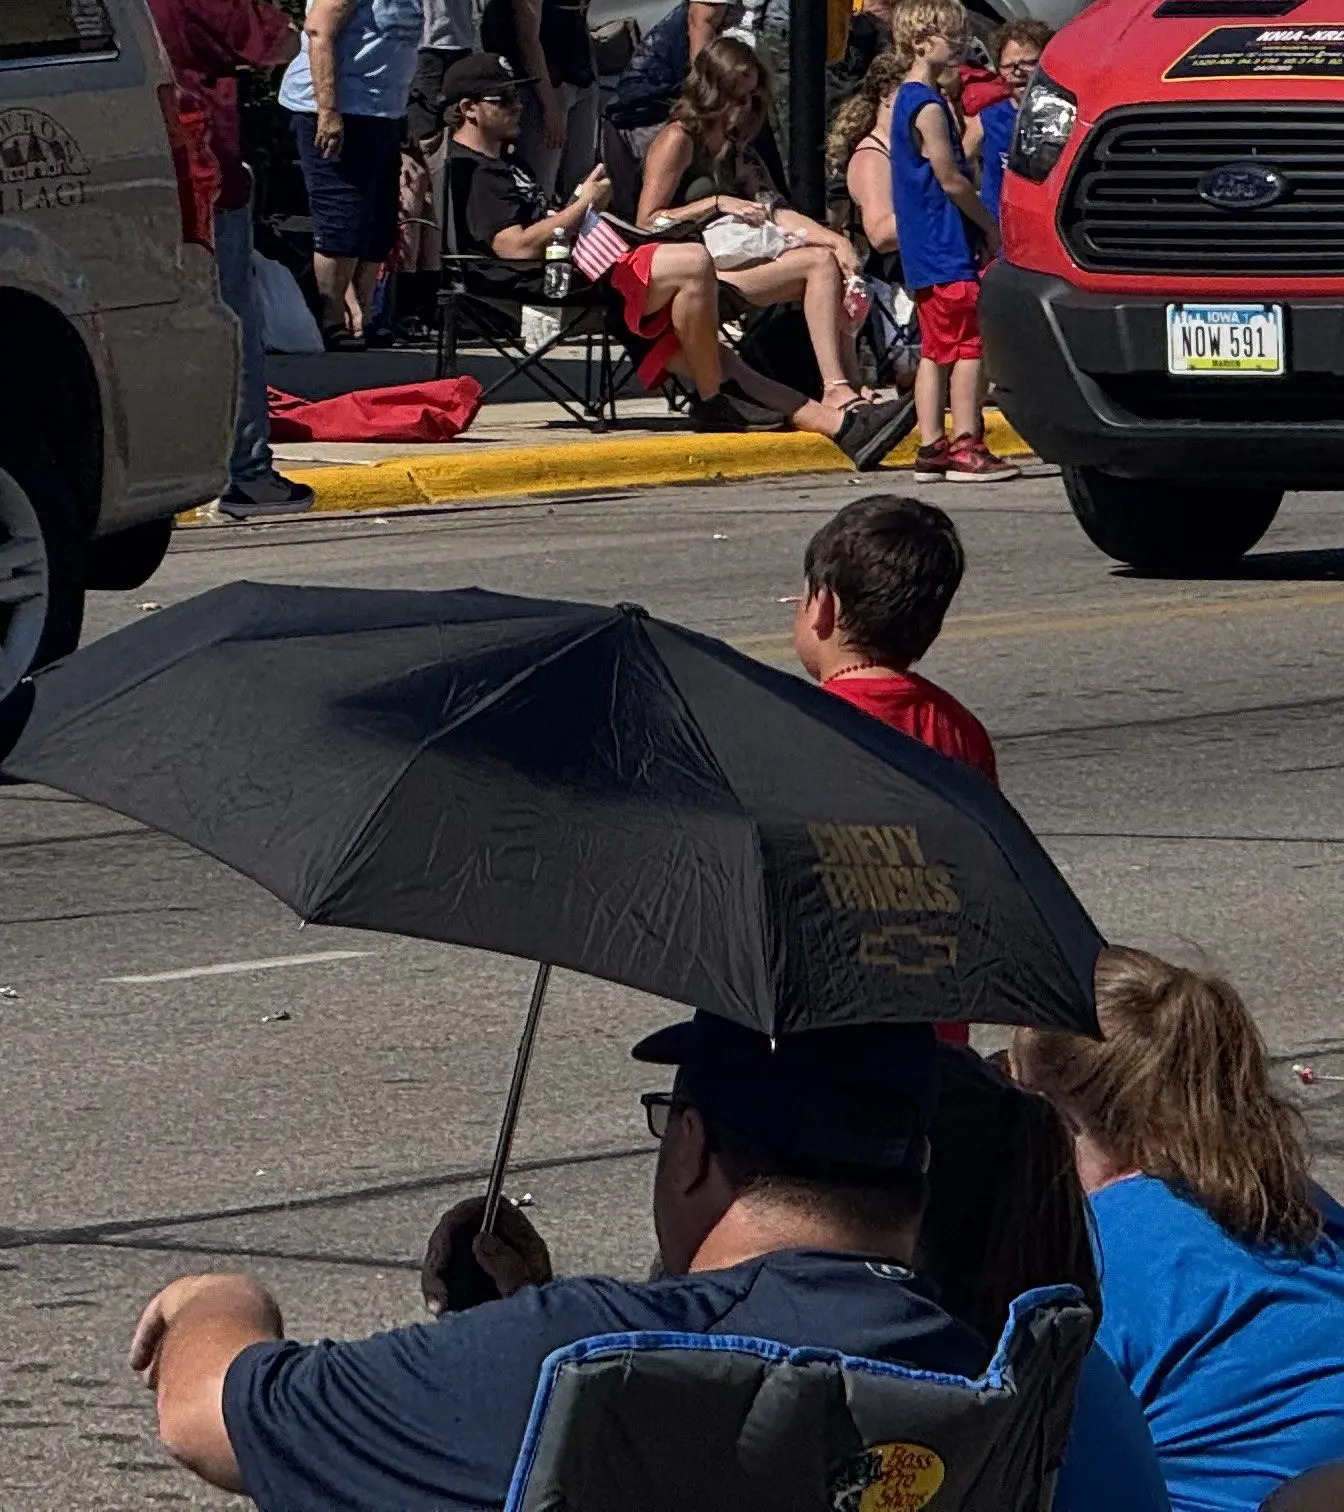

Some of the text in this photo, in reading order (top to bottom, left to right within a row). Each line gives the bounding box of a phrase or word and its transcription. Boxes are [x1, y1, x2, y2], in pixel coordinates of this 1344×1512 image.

[1207, 311, 1240, 324] IOWA
[1182, 326, 1266, 357] NOW 591
[805, 821, 927, 867] CHEVY
[811, 864, 961, 912] TRUCKS
